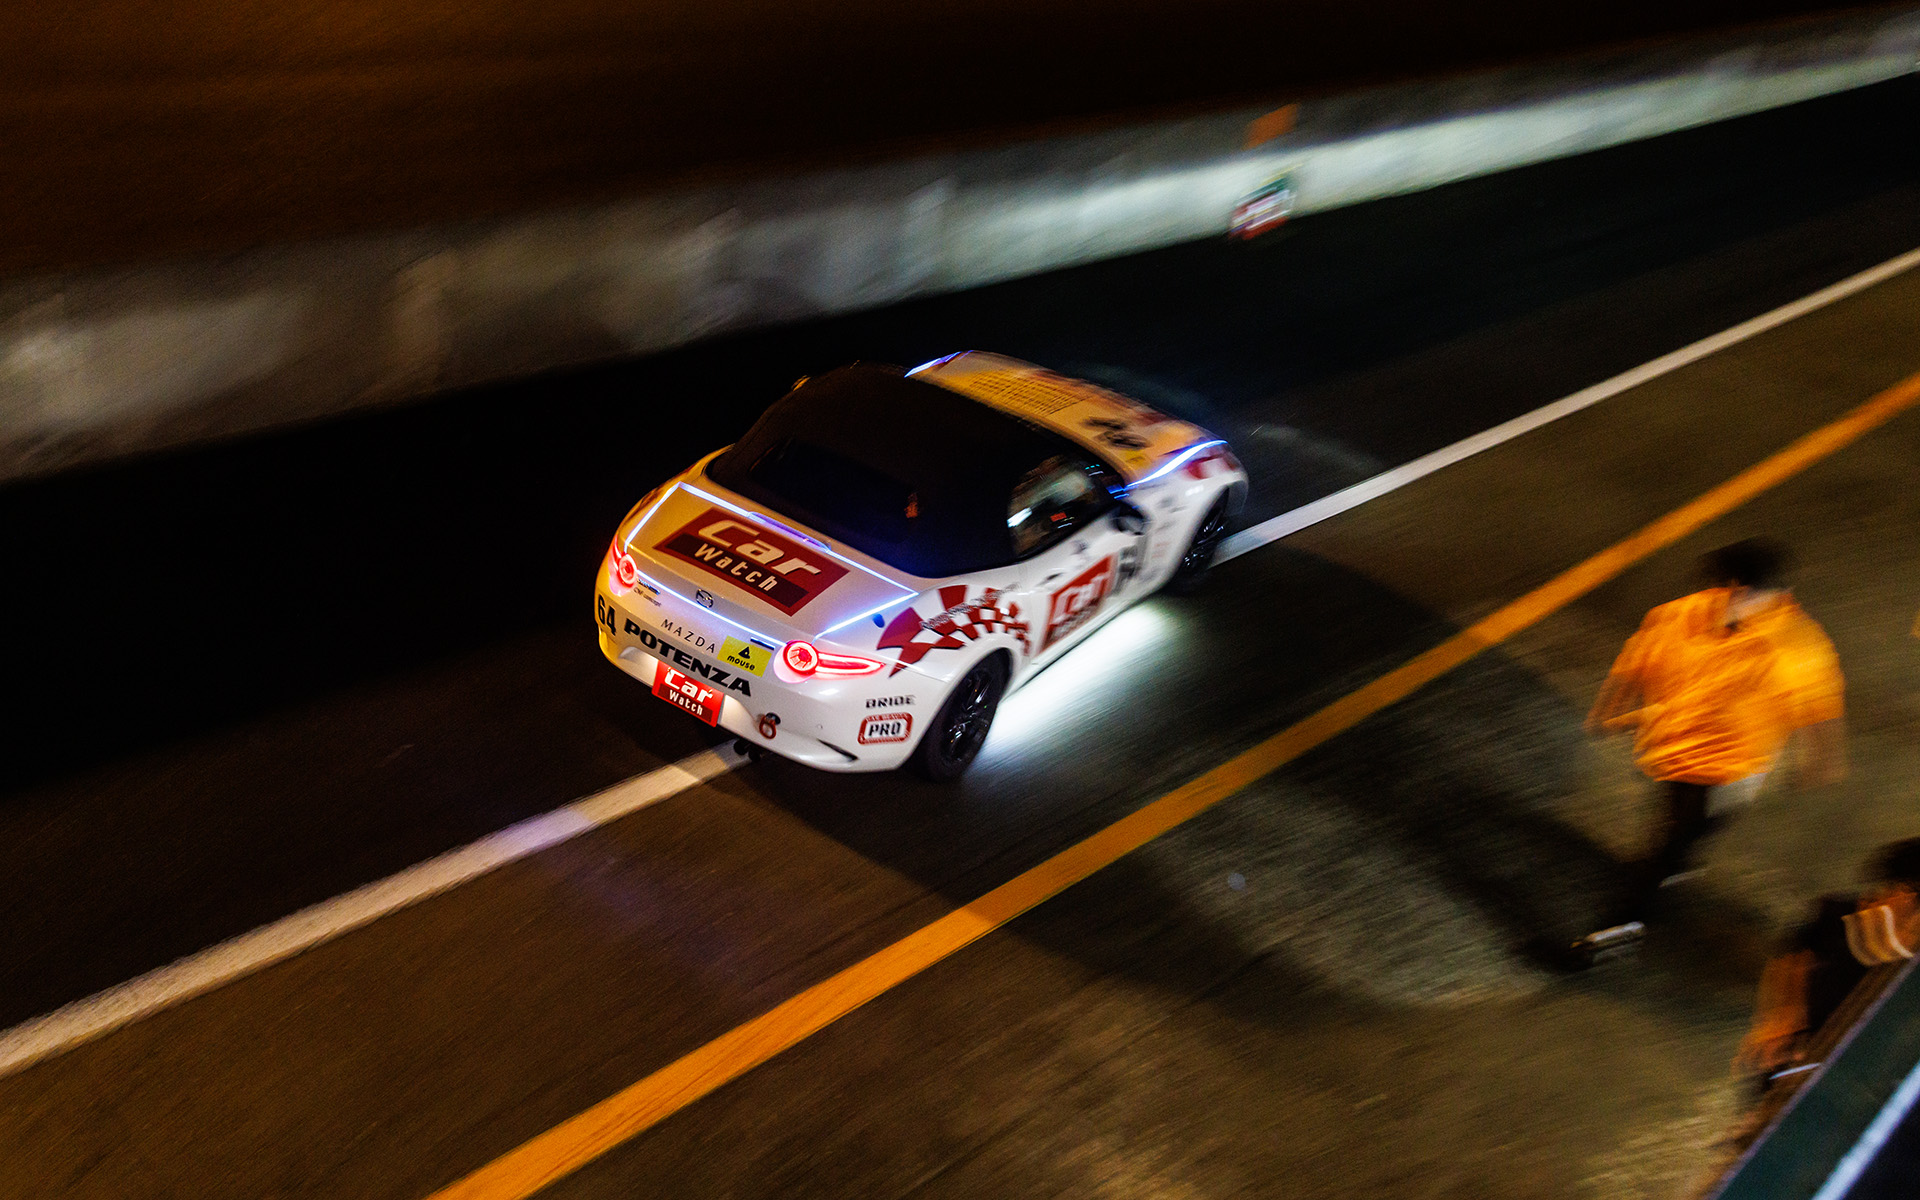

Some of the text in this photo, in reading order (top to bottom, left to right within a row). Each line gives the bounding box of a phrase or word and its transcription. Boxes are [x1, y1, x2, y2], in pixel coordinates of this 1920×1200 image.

[698, 519, 821, 575] Car
[694, 543, 778, 591] Watch
[598, 593, 616, 636] 64
[661, 618, 716, 654] MAZDA
[624, 617, 752, 697] POTENZA
[726, 655, 756, 671] mouse
[664, 666, 713, 703] Car
[669, 689, 703, 716] Watch
[868, 721, 901, 737] PRO
